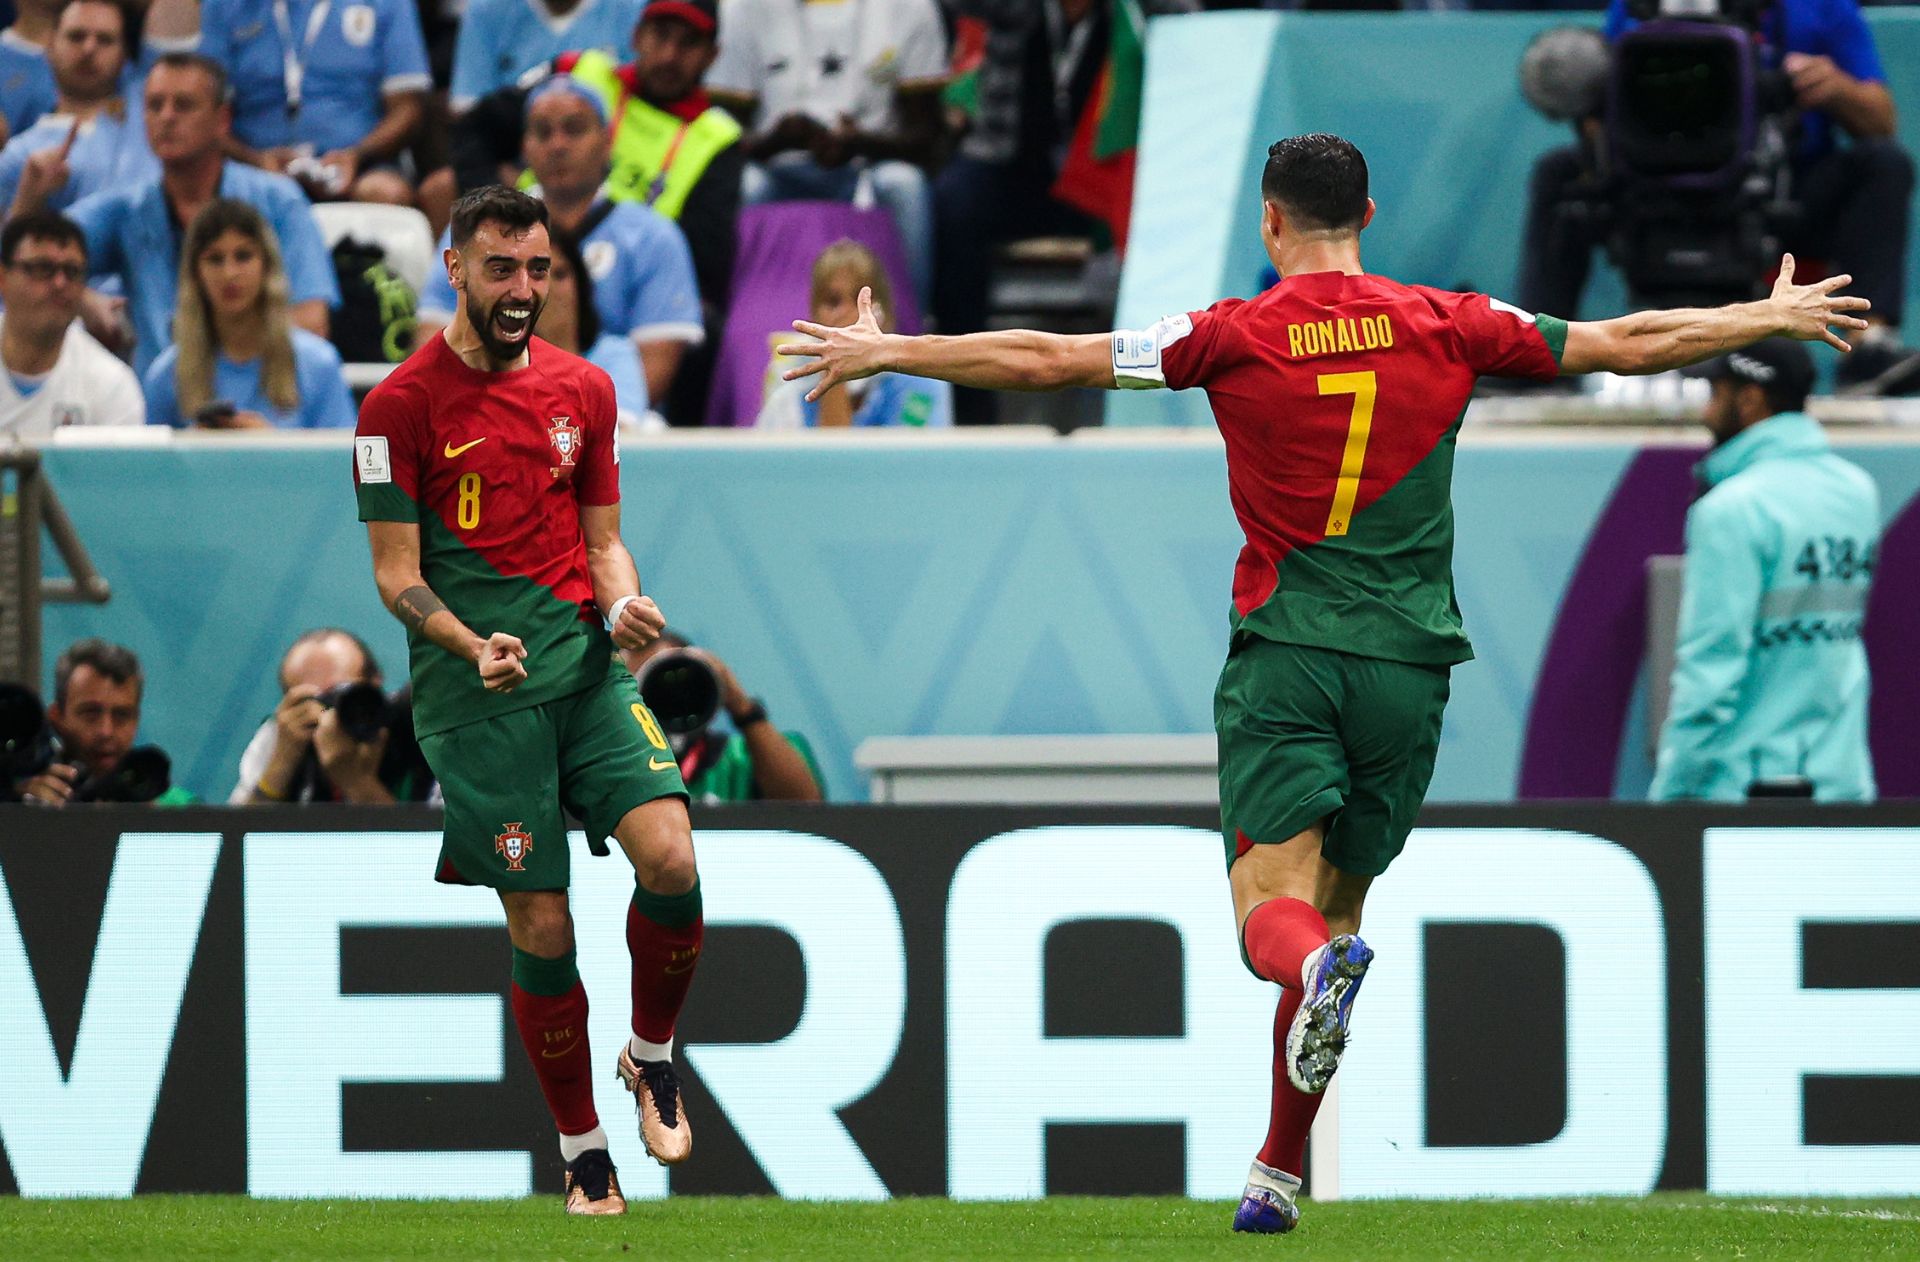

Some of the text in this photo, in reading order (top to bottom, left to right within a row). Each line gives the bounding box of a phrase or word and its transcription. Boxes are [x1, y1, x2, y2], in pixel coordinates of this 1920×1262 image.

[1287, 313, 1394, 357] RONALDO
[1317, 370, 1377, 537] 7
[457, 472, 481, 530] 8
[630, 702, 668, 751] 8
